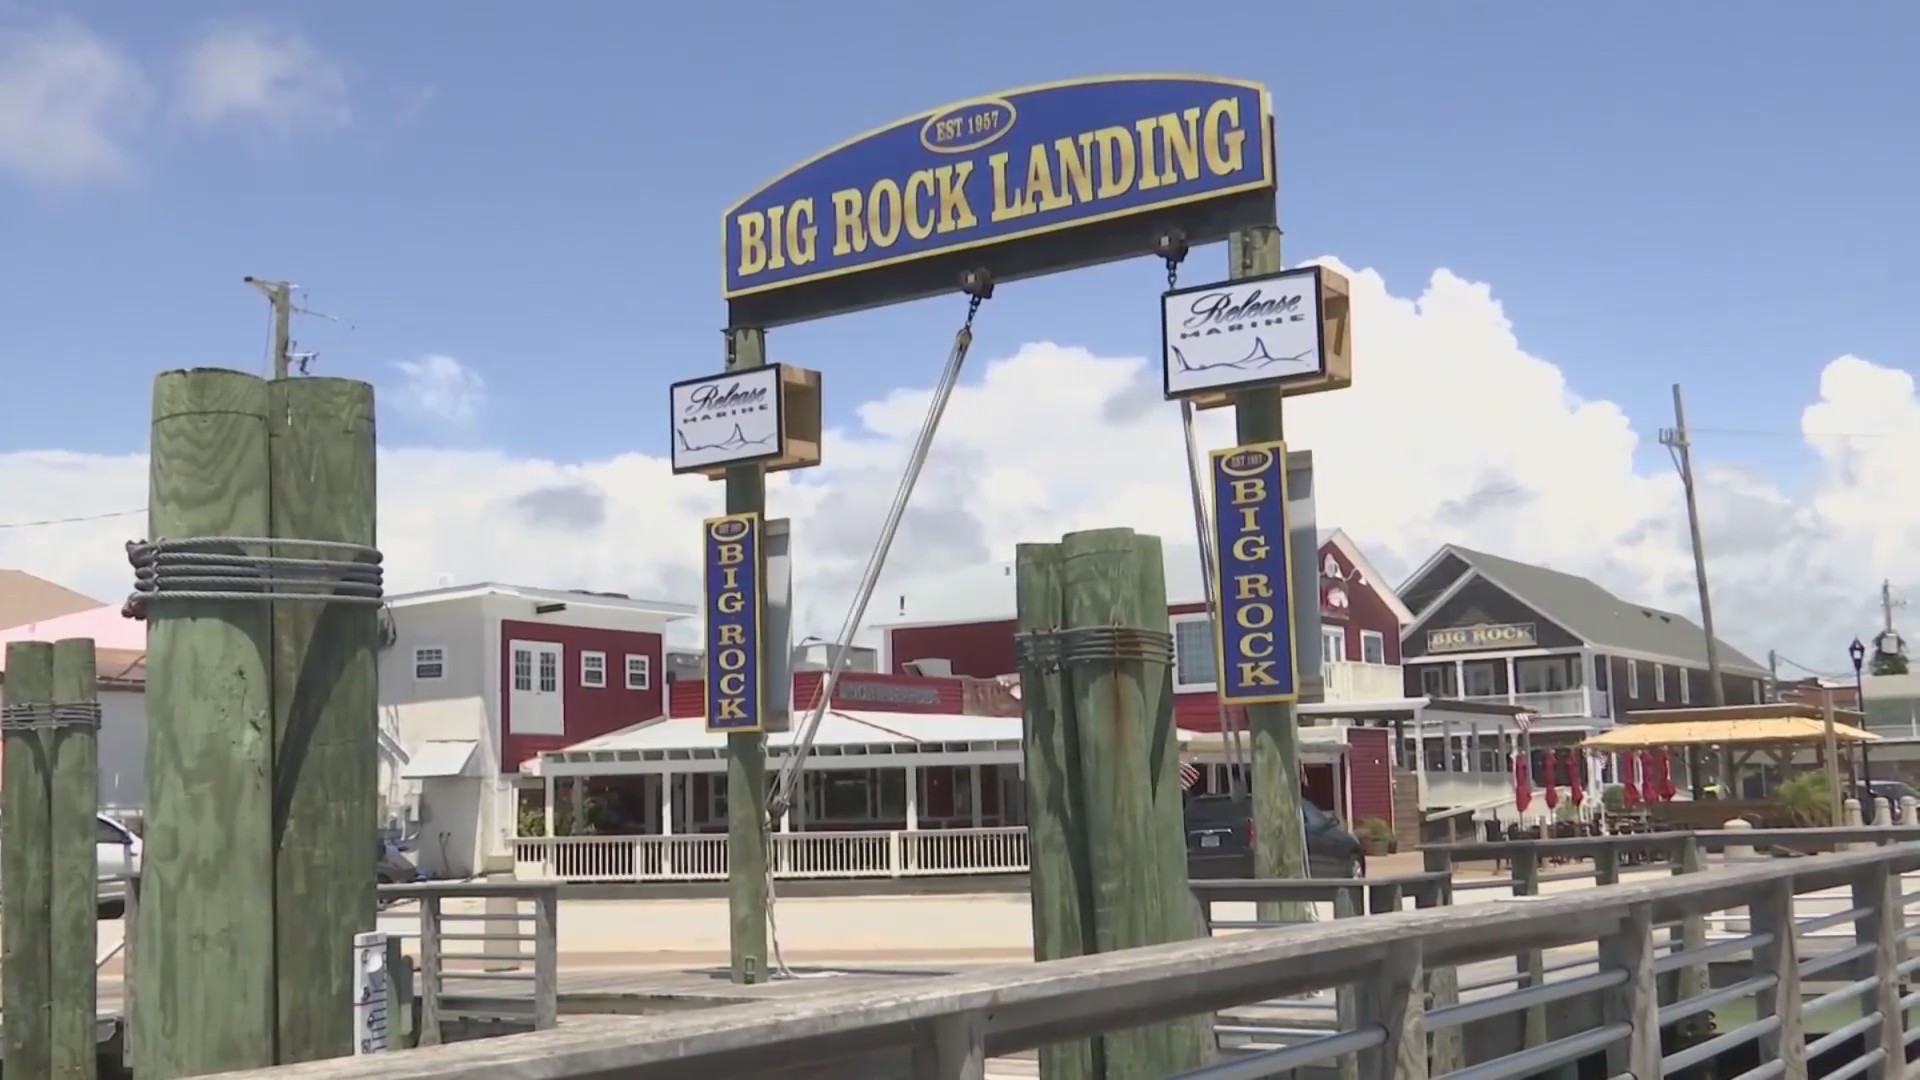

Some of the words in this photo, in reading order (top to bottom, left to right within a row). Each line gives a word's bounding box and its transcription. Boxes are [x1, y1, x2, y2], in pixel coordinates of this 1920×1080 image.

[935, 120, 963, 141] EST
[968, 110, 1000, 136] 1957
[737, 197, 818, 276] BIG
[831, 160, 977, 257] ROCK
[988, 96, 1246, 223] LANDING
[1180, 313, 1306, 340] MARINE
[1182, 288, 1303, 330] Release
[685, 382, 768, 415] Release
[1230, 478, 1270, 562] BIG
[717, 543, 745, 614] BIG
[1234, 574, 1280, 687] ROCK
[1432, 630, 1467, 646] BIG
[1472, 625, 1533, 643] ROCK
[717, 623, 748, 720] ROCK
